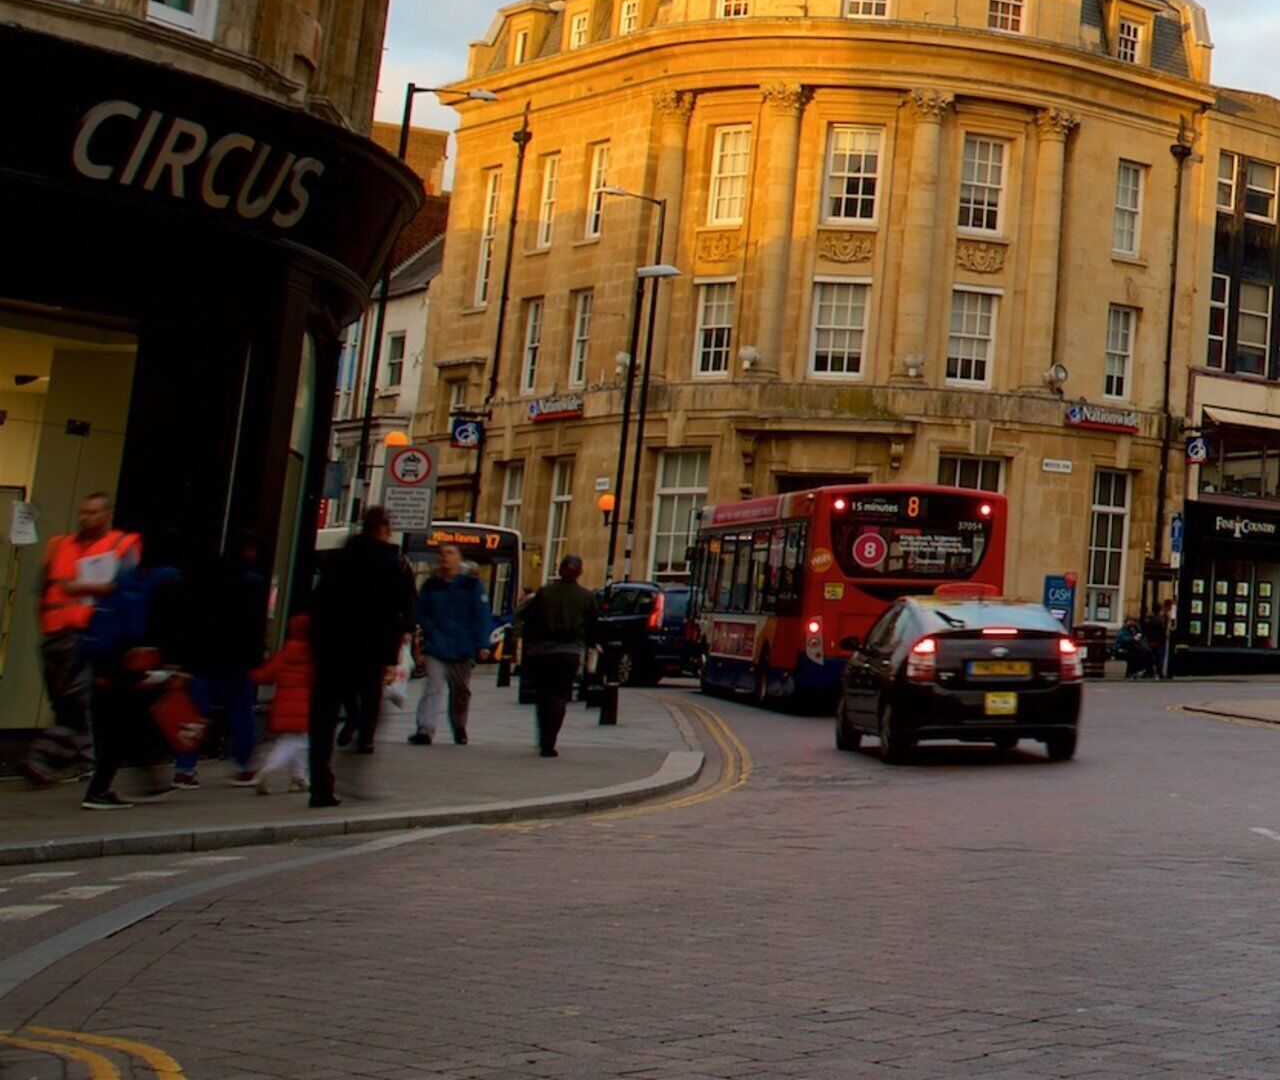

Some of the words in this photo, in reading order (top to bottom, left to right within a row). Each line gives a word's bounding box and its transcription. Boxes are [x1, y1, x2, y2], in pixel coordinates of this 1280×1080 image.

[72, 99, 326, 229] CIRCUS
[1081, 405, 1139, 427] Nationwide
[864, 502, 899, 513] minutes
[907, 495, 921, 518] 8
[485, 533, 500, 550] X7
[863, 541, 877, 558] 8
[1048, 587, 1072, 601] CASH
